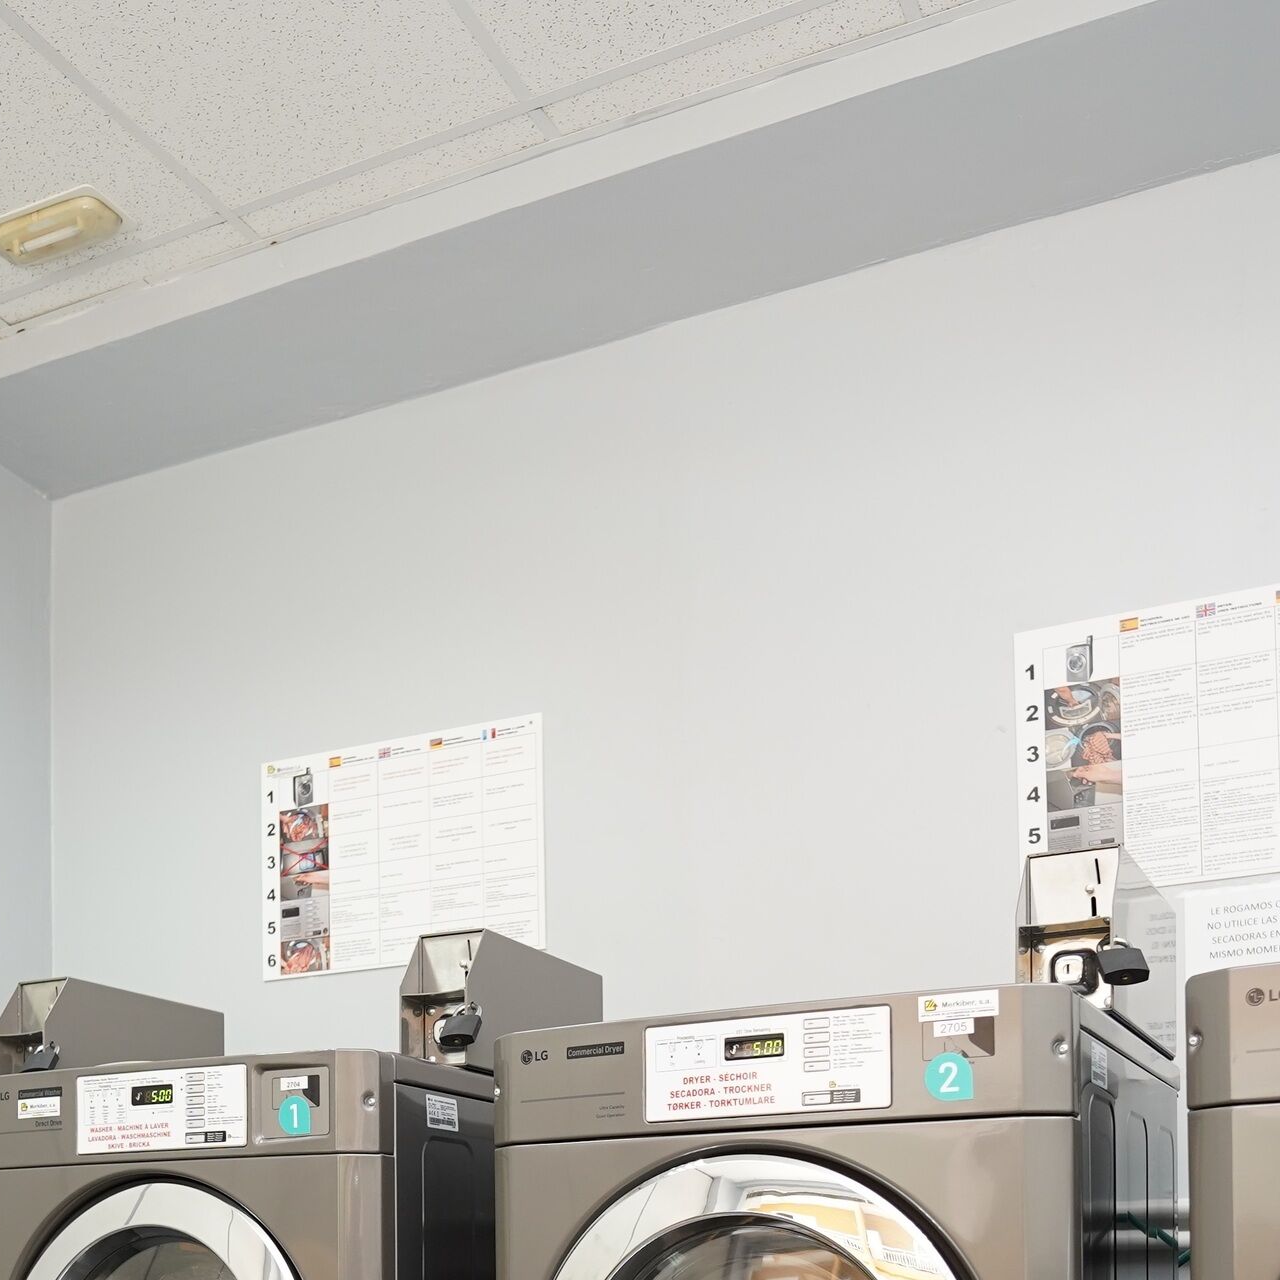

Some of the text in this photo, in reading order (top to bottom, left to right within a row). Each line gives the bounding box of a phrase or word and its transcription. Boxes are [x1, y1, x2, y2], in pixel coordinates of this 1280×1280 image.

[1025, 664, 1036, 680] 1
[1026, 706, 1040, 722] 2
[1027, 746, 1040, 762] 3
[267, 790, 275, 803] 1
[1026, 786, 1041, 803] 4
[267, 824, 276, 836] 2
[1028, 827, 1042, 845] 5
[267, 856, 276, 869] 3
[267, 889, 277, 901] 4
[1210, 907, 1221, 916] LE
[1223, 900, 1273, 914] ROGAMOS
[267, 922, 276, 934] 5
[1207, 921, 1222, 931] NO
[1224, 917, 1259, 929] UTILICE
[1261, 915, 1278, 925] LAS
[1211, 931, 1268, 945] SECADORAS
[267, 954, 276, 967] 6
[1209, 948, 1244, 960] MISMO
[940, 1022, 968, 1034] 2705
[535, 1050, 548, 1061] LG
[567, 1044, 624, 1057] Commercial Dryer
[683, 1075, 711, 1085] DRYER
[938, 1061, 960, 1093] 2
[0, 1091, 10, 1101] LG
[670, 1083, 772, 1099] SECADORA TROCKNER
[667, 1096, 776, 1111] TØRKER TORKTUMLARE
[289, 1103, 298, 1129] 1
[50, 1119, 62, 1127] Drive
[90, 1125, 113, 1133] WASHER
[150, 1122, 169, 1130] LAVER
[88, 1131, 171, 1142] LAVADORA WASCHMASCHINE
